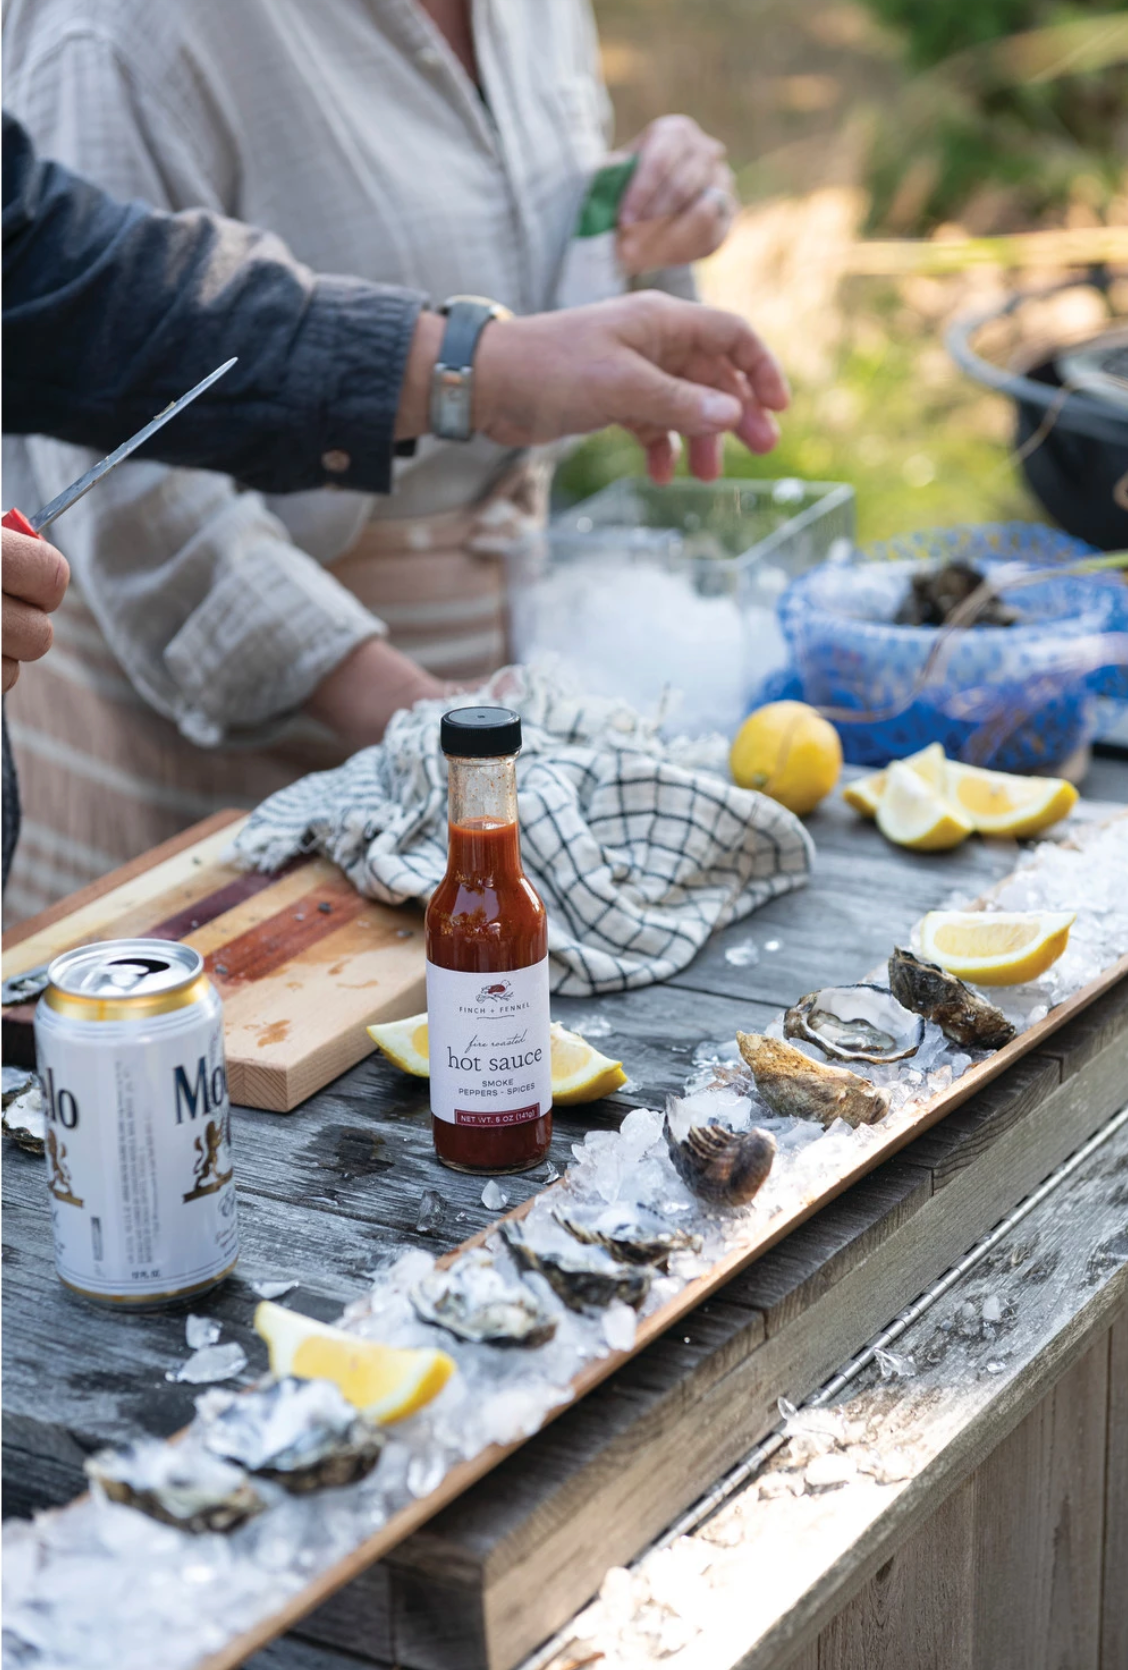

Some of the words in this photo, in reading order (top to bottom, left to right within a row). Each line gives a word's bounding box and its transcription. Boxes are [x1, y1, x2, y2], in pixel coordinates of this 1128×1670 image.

[459, 1006, 486, 1014] FINCH
[500, 1002, 530, 1013] FENNEL
[464, 1035, 488, 1054] fire
[491, 1029, 528, 1047] roasted
[447, 1046, 481, 1072] hot
[489, 1048, 542, 1072] sauce
[482, 1078, 514, 1087] SMOKE
[458, 1088, 498, 1097] PEPPERS
[507, 1082, 536, 1095] SPICES
[461, 1115, 476, 1123] NET
[478, 1116, 494, 1124] WT.
[502, 1115, 514, 1123] OZ
